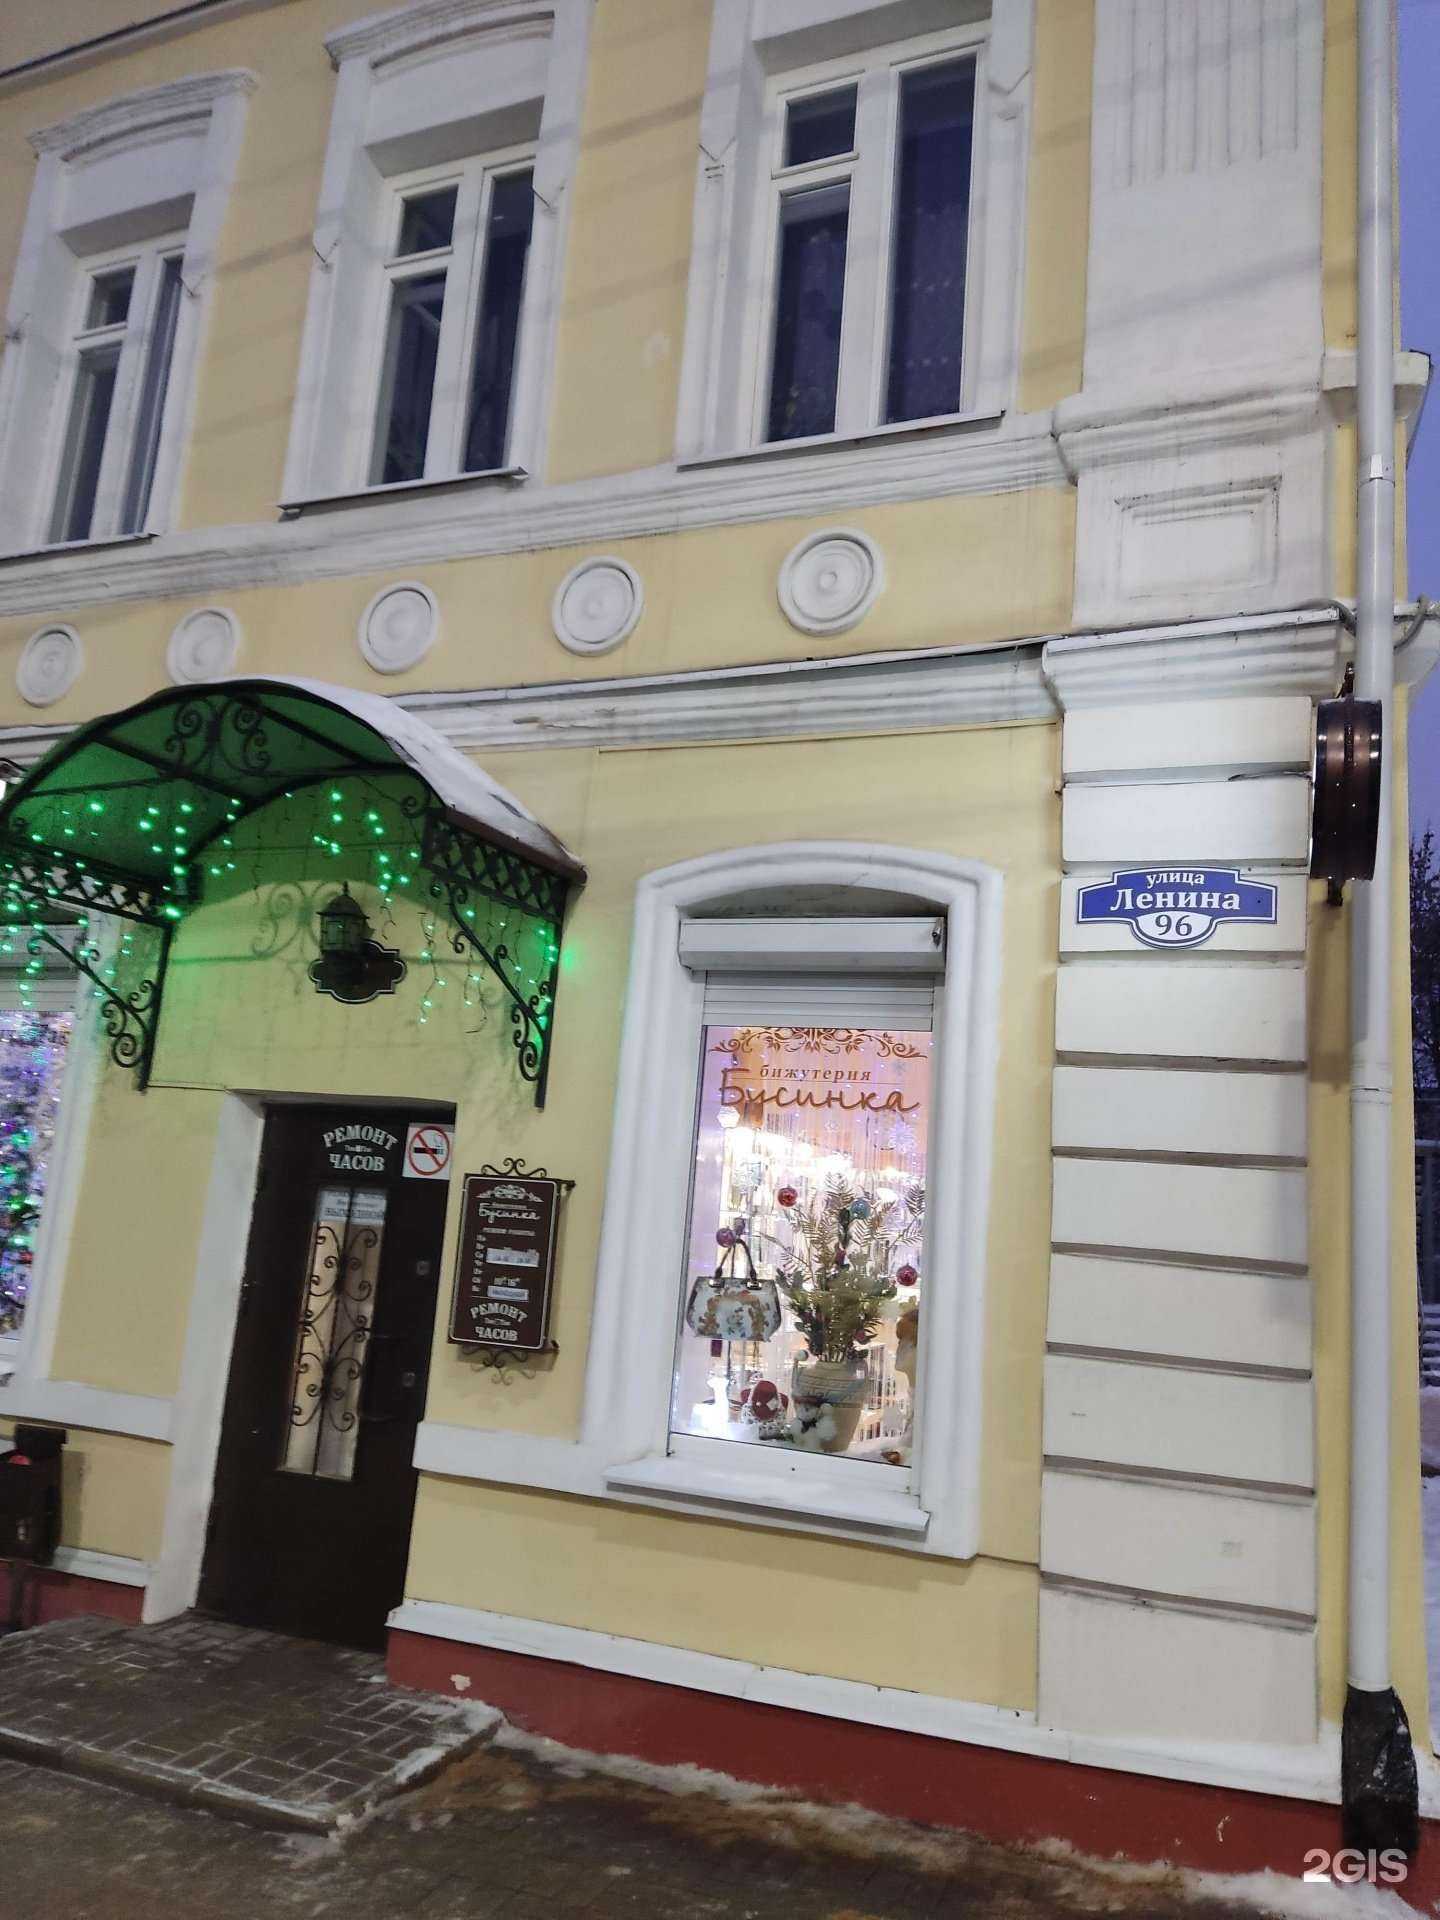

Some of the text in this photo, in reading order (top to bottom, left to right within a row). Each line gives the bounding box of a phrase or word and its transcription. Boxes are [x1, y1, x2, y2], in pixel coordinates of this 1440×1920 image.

[1146, 872, 1205, 889] улица
[1109, 888, 1241, 911] Ленина
[1155, 914, 1193, 937] 96
[759, 1063, 872, 1084] бижутерия
[718, 1068, 920, 1119] Бусинка
[323, 1125, 399, 1150] РЕМОНТ
[329, 1153, 385, 1172] ЧАСОВ
[470, 1302, 528, 1323] РЕМОНТ
[475, 1326, 518, 1342] ЧАСОВ
